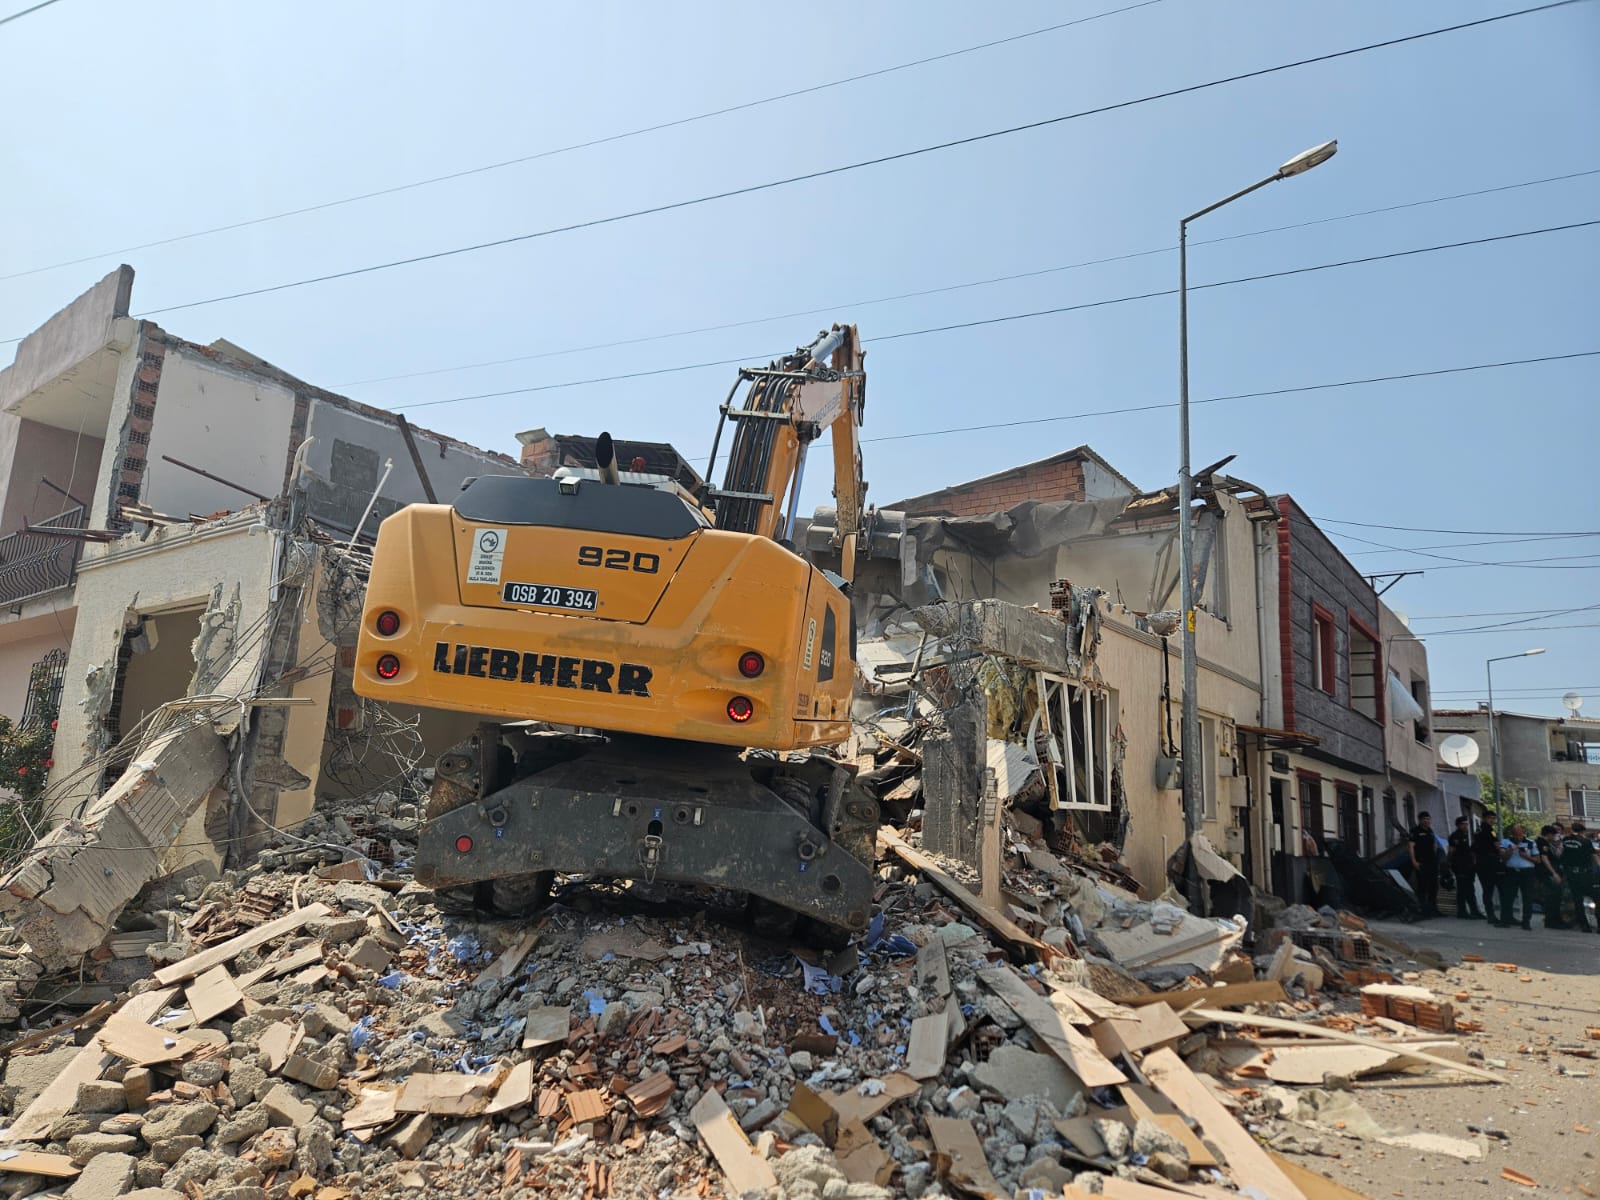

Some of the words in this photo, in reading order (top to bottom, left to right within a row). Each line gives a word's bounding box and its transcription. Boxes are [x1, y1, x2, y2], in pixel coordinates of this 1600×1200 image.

[578, 546, 660, 575] 920
[541, 587, 560, 605] 20
[565, 590, 593, 609] 394
[433, 642, 653, 697] LIEBHERR
